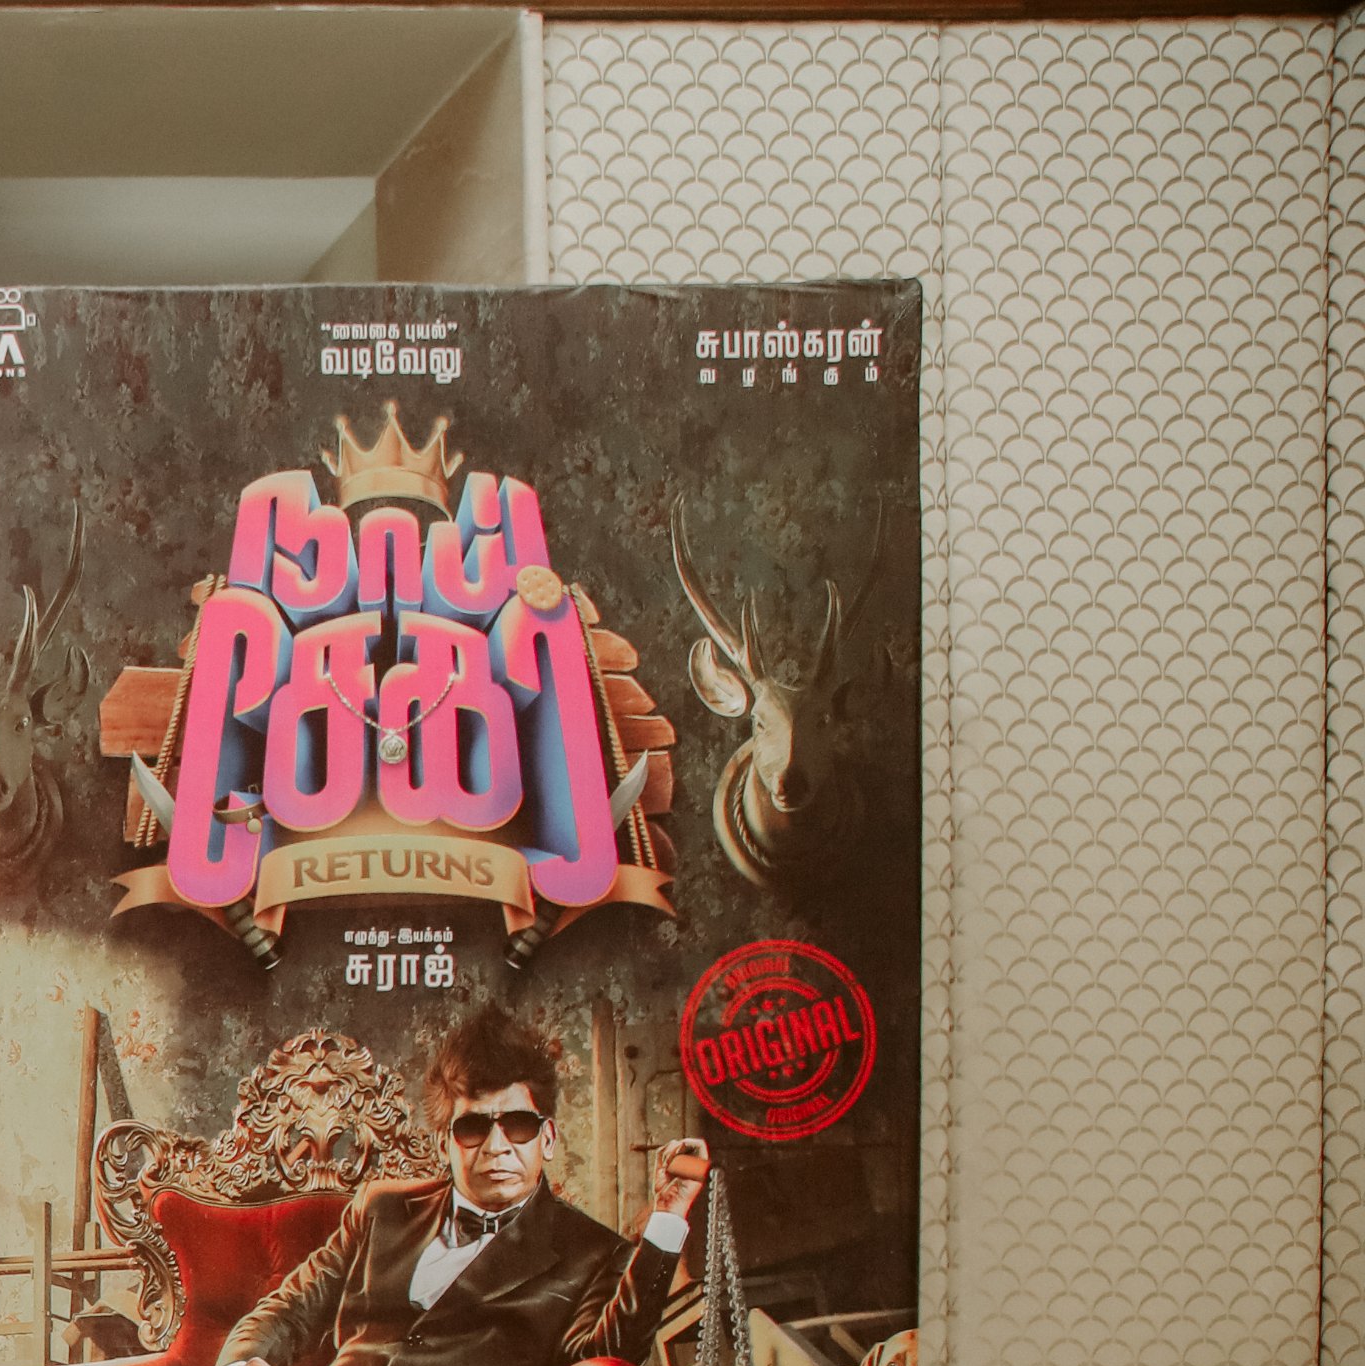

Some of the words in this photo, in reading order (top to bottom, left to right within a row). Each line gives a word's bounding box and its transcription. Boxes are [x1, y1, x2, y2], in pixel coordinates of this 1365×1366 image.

[321, 340, 461, 384] வடிவேலு
[695, 319, 882, 363] சுபாஸ்கரன்
[226, 470, 557, 628] நாய்
[292, 848, 496, 889] RETURNS
[345, 943, 455, 992] சுராஜ்
[696, 996, 862, 1086] ORIGINAL
